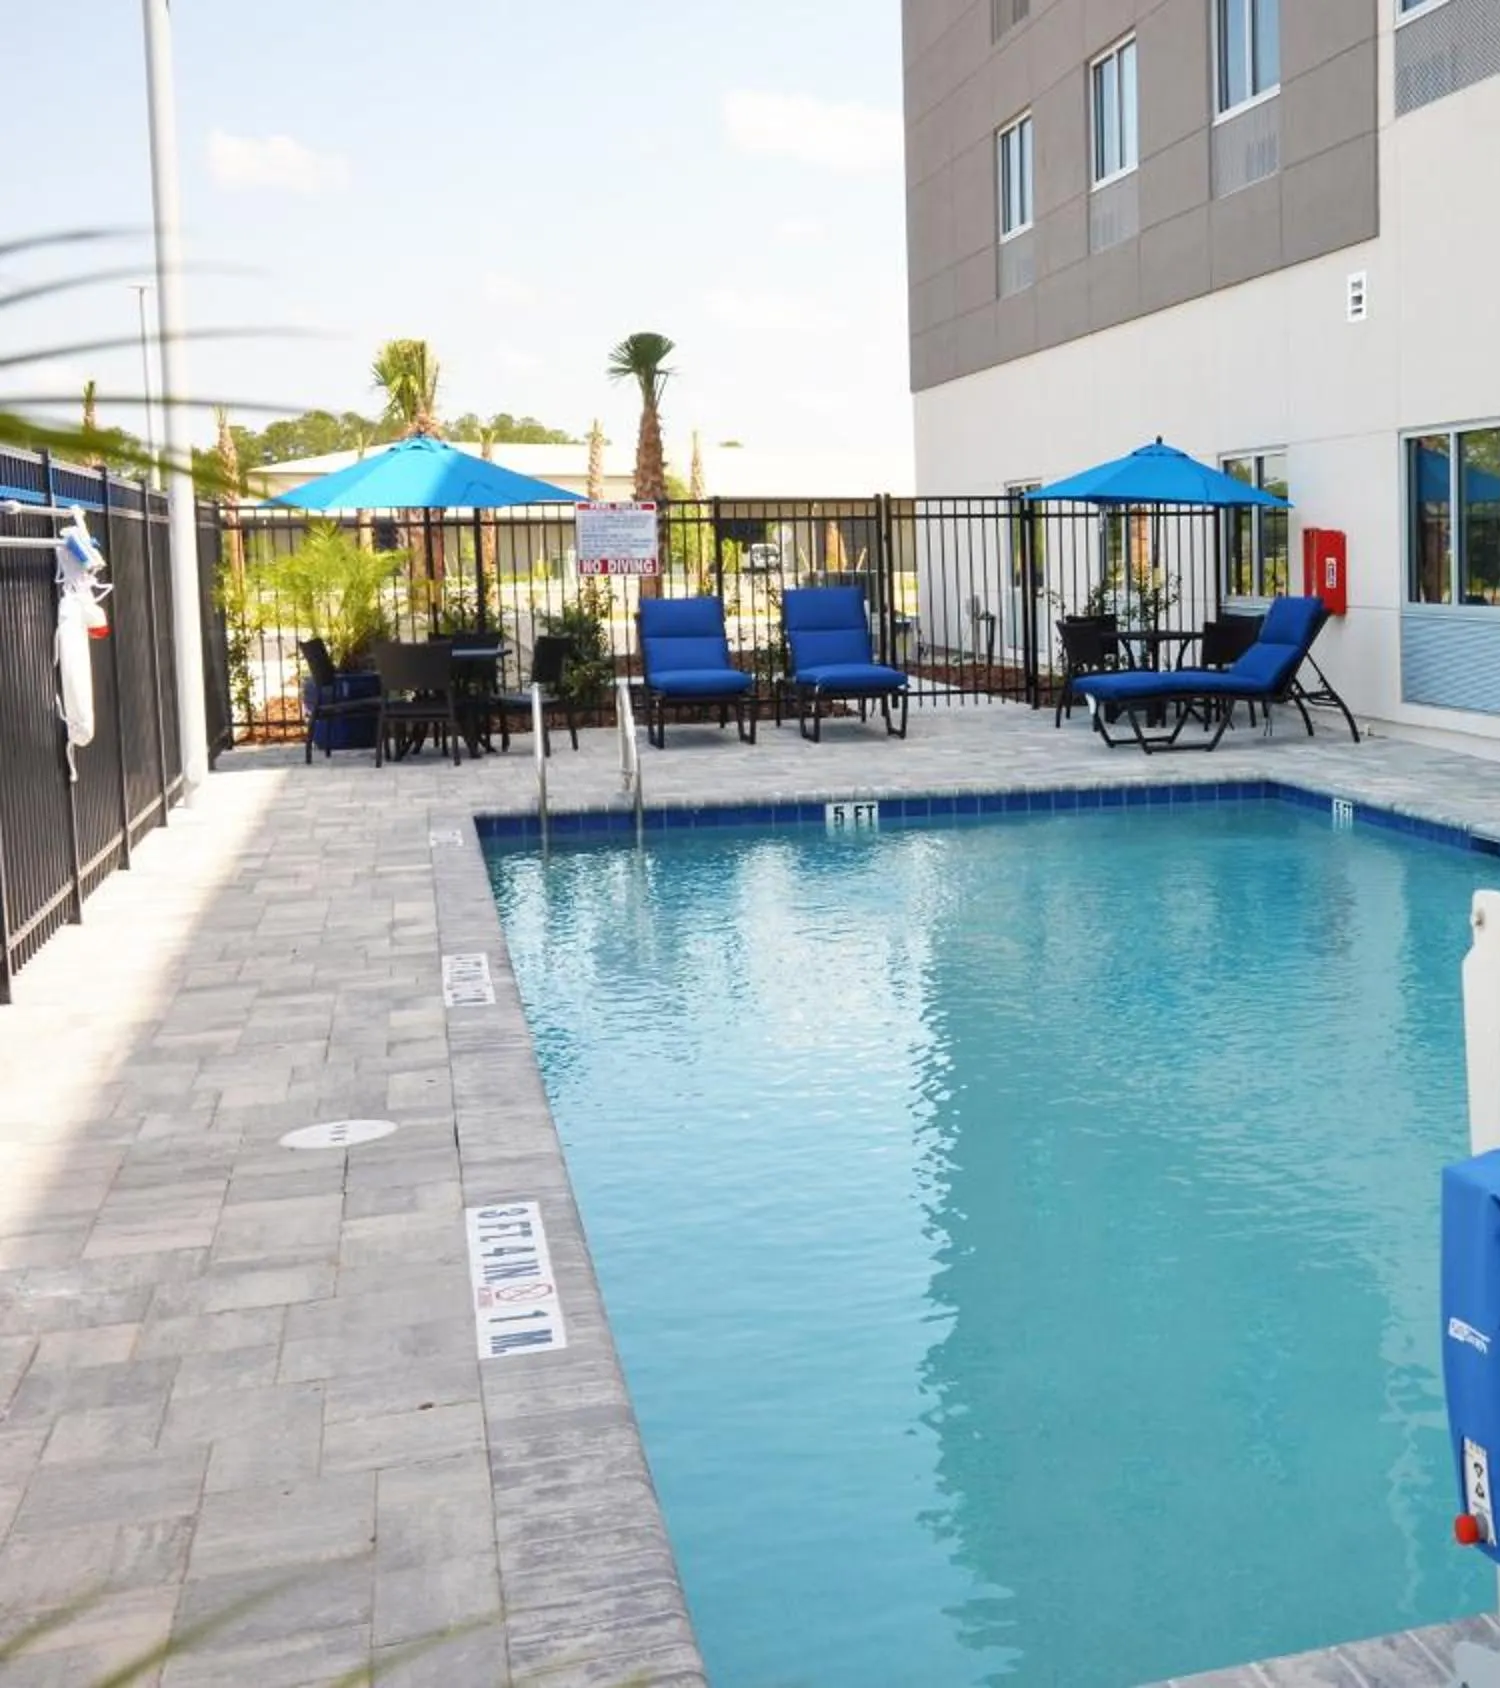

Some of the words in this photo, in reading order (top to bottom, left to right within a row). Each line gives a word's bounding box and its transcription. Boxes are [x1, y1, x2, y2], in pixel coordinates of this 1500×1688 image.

[582, 560, 601, 573] NO
[608, 560, 654, 573] DIVING
[834, 805, 844, 827] 5
[854, 804, 876, 827] FT
[477, 1207, 529, 1219] 3
[480, 1247, 536, 1257] 4
